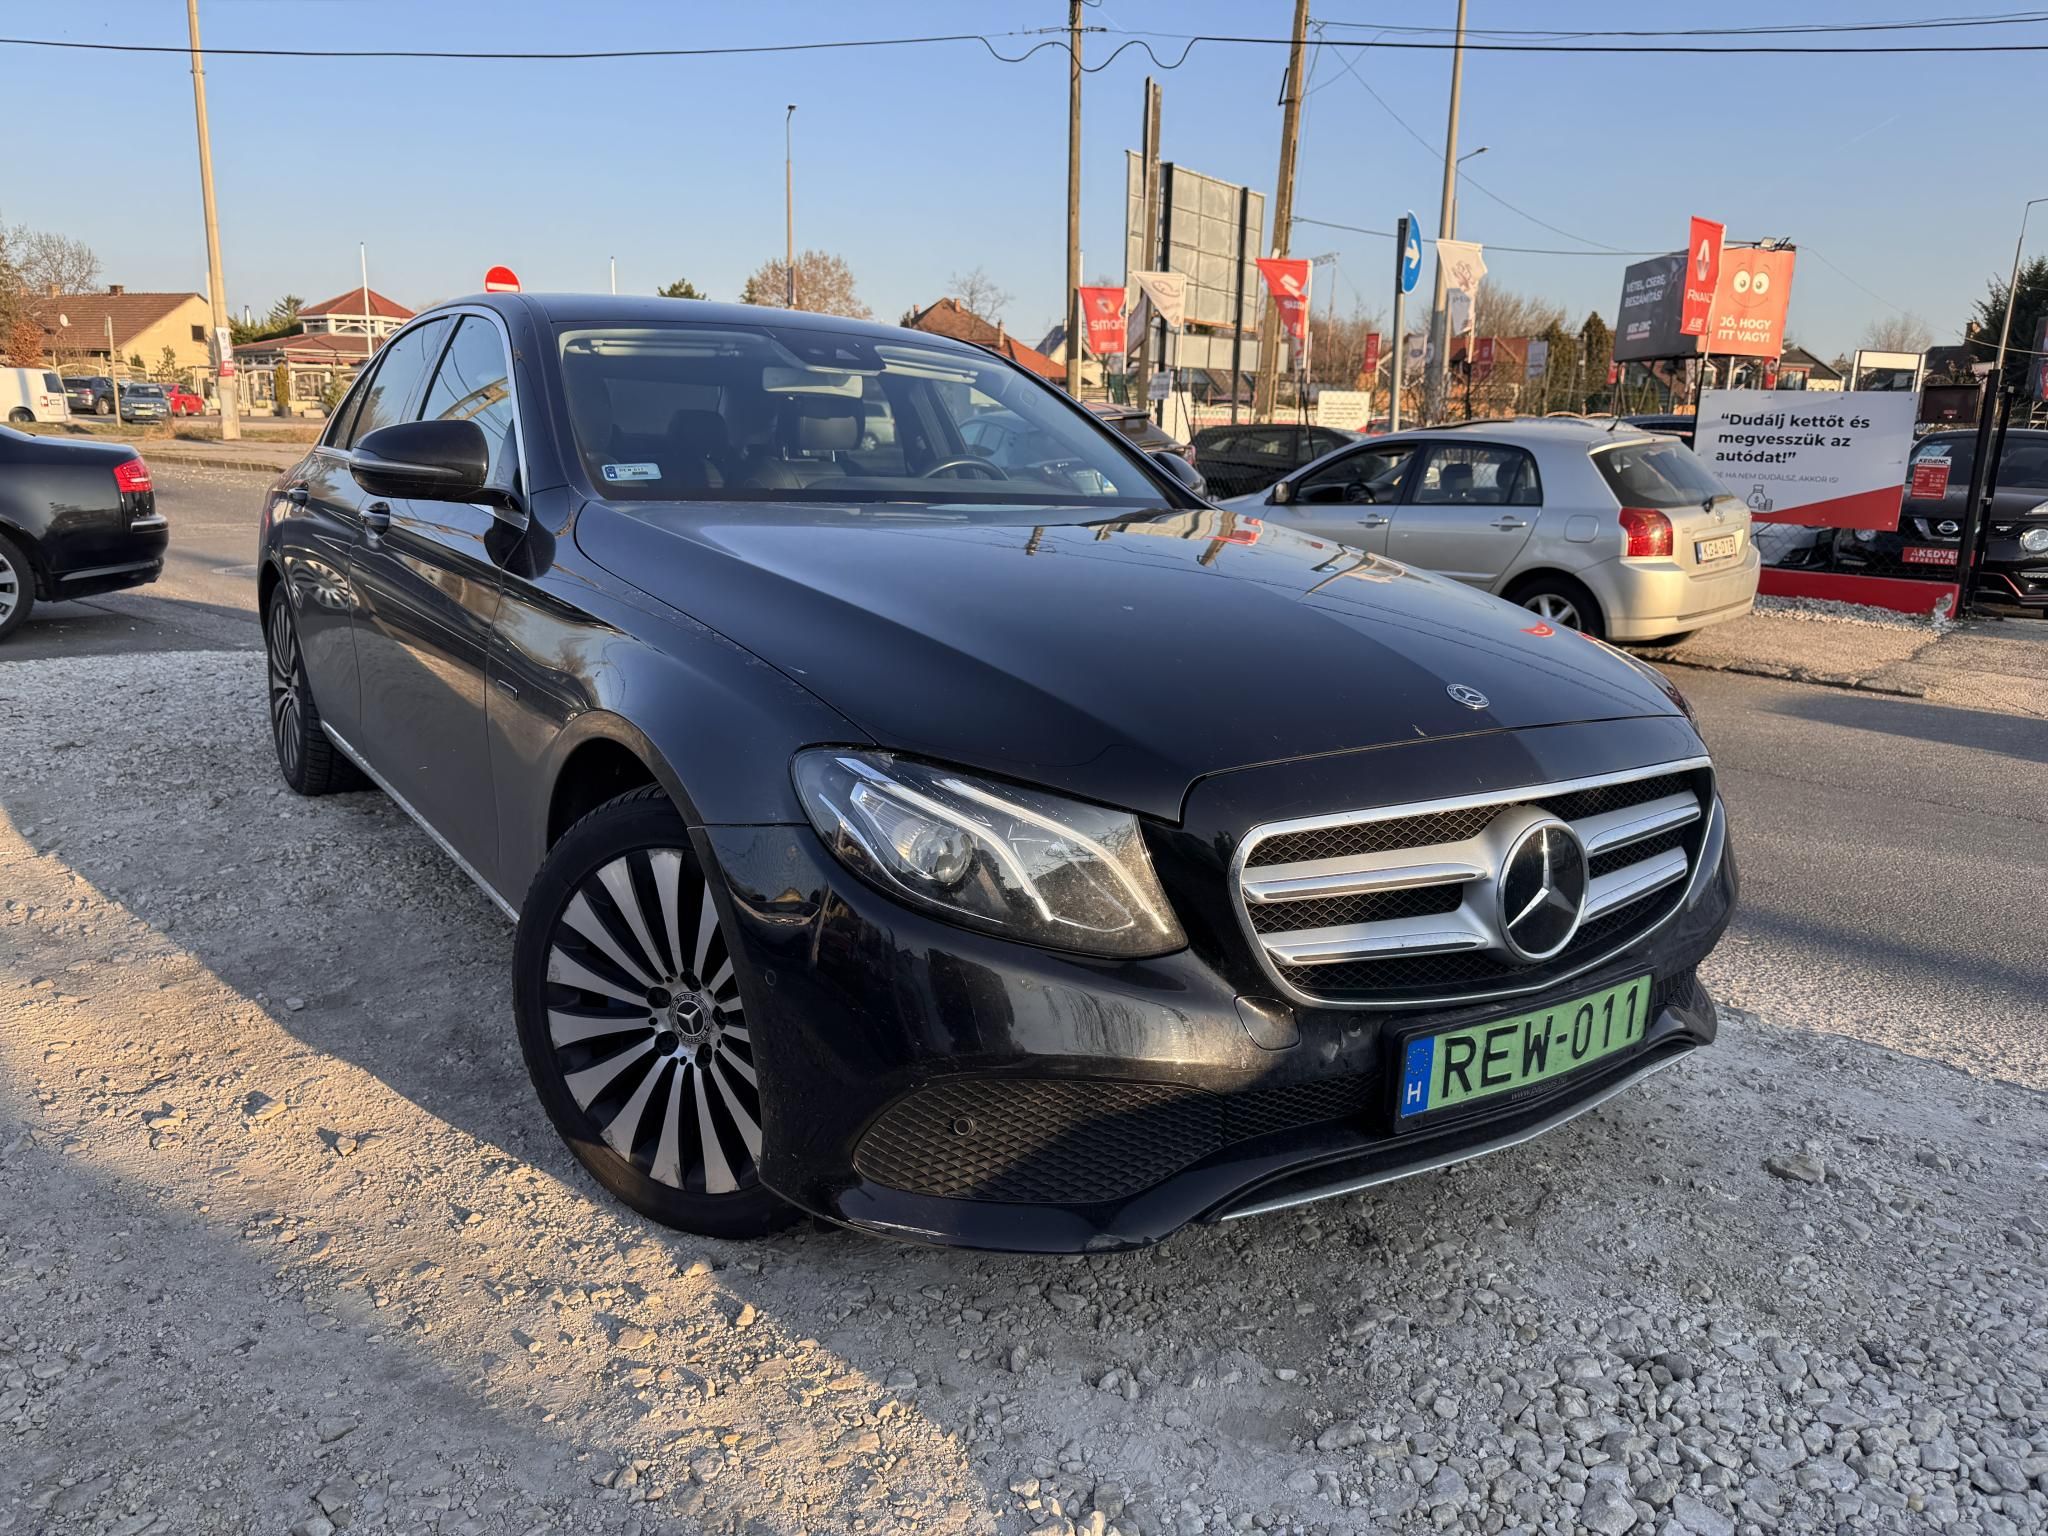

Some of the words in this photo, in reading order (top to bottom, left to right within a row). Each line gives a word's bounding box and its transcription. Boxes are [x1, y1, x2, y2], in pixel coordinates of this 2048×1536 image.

[1740, 318, 1771, 330] HOGY
[1718, 330, 1735, 340] ITT
[1737, 330, 1770, 343] VAGY!
[1790, 414, 1844, 428] kettőt
[1850, 415, 1870, 428] és
[1718, 433, 1825, 446] megvesszük
[1831, 437, 1851, 447] az
[1738, 472, 1757, 480] NEM
[1441, 984, 1640, 1098] REW-011
[1406, 1081, 1422, 1104] H
